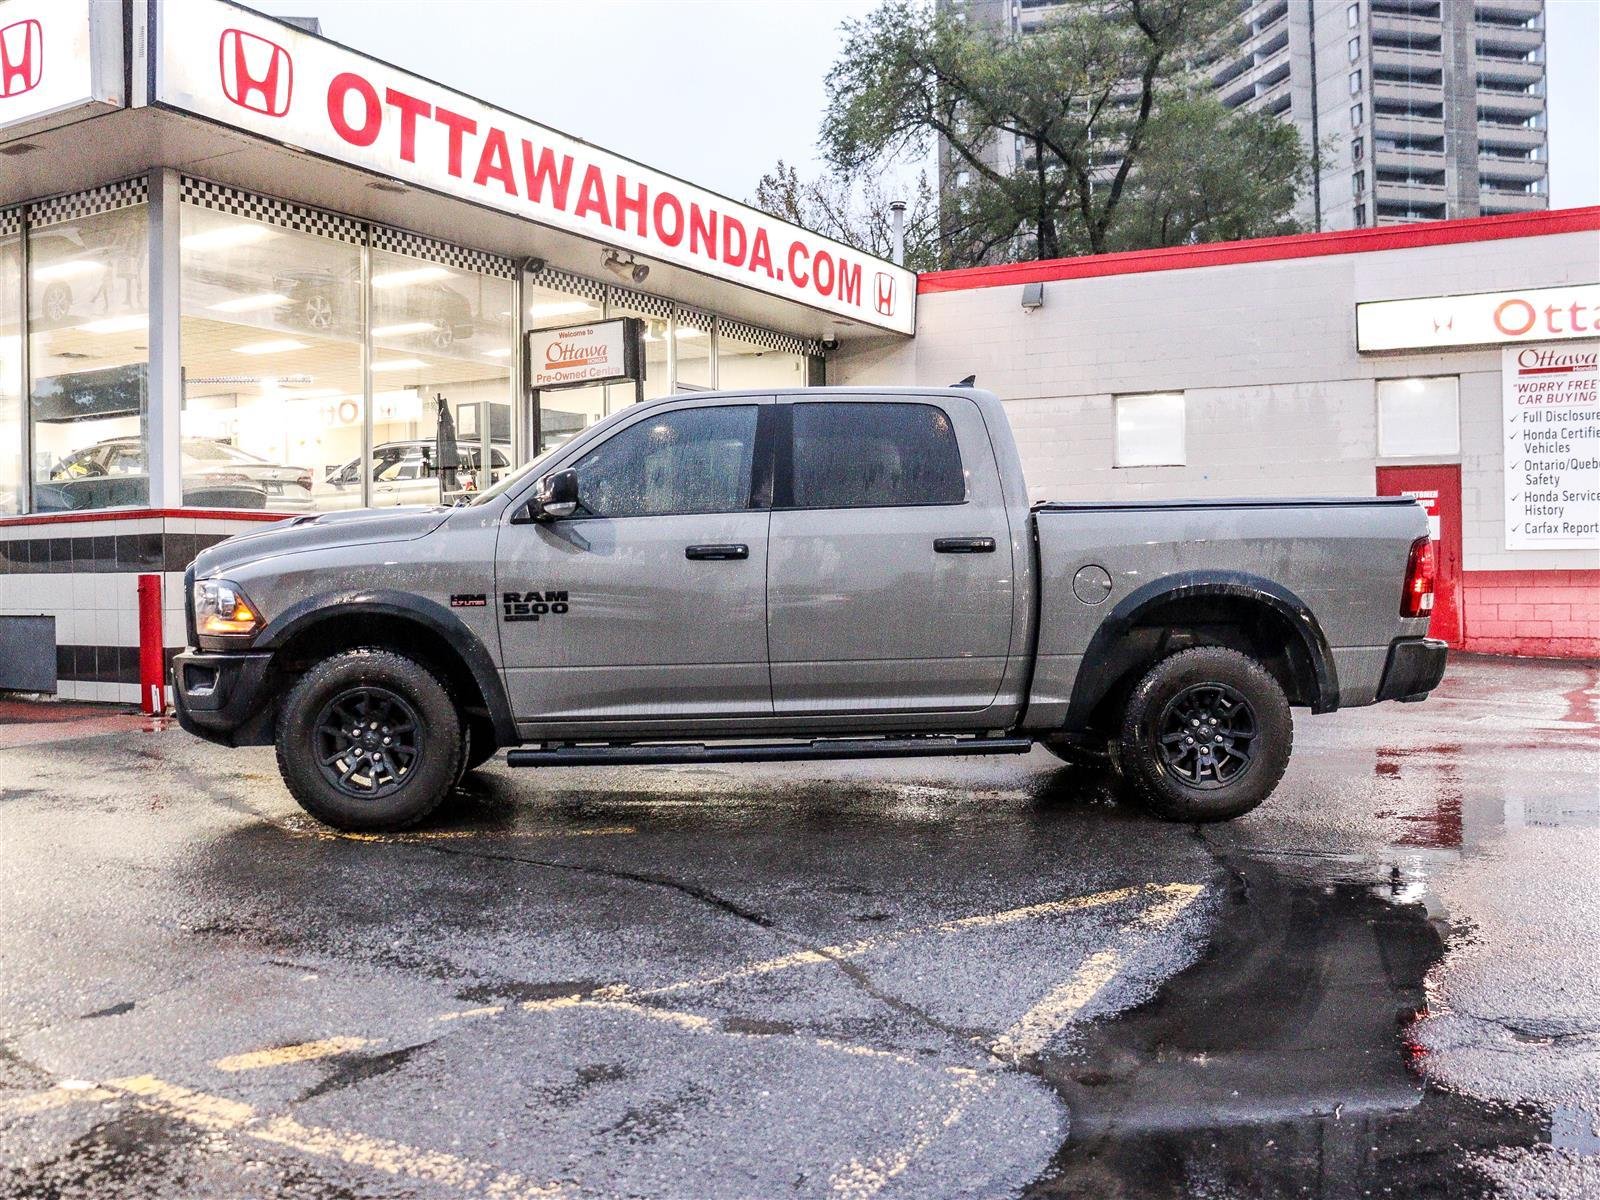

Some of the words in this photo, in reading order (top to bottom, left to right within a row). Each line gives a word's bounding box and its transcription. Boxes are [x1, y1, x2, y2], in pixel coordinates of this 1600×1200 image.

[326, 72, 862, 307] OTTAWAHONDA.COM
[559, 331, 586, 339] Welcome
[546, 342, 608, 362] Ottawa
[1518, 349, 1598, 368] Ottawa
[536, 369, 587, 384] Pre-Owned
[589, 365, 620, 377] Centre
[1567, 379, 1598, 391] FREE
[1518, 394, 1543, 405] CAR
[1546, 391, 1598, 404] BUYING
[1523, 411, 1542, 423] Full
[1523, 428, 1557, 440] Honda
[1524, 441, 1570, 454] Vehicles
[1524, 457, 1600, 472] Ontario/Queb
[1525, 473, 1560, 488] Safety
[1524, 490, 1559, 502] Honda
[1525, 504, 1564, 518] History
[1524, 521, 1559, 534] Carfax
[503, 591, 569, 603] RAM
[503, 603, 569, 615] 1500
